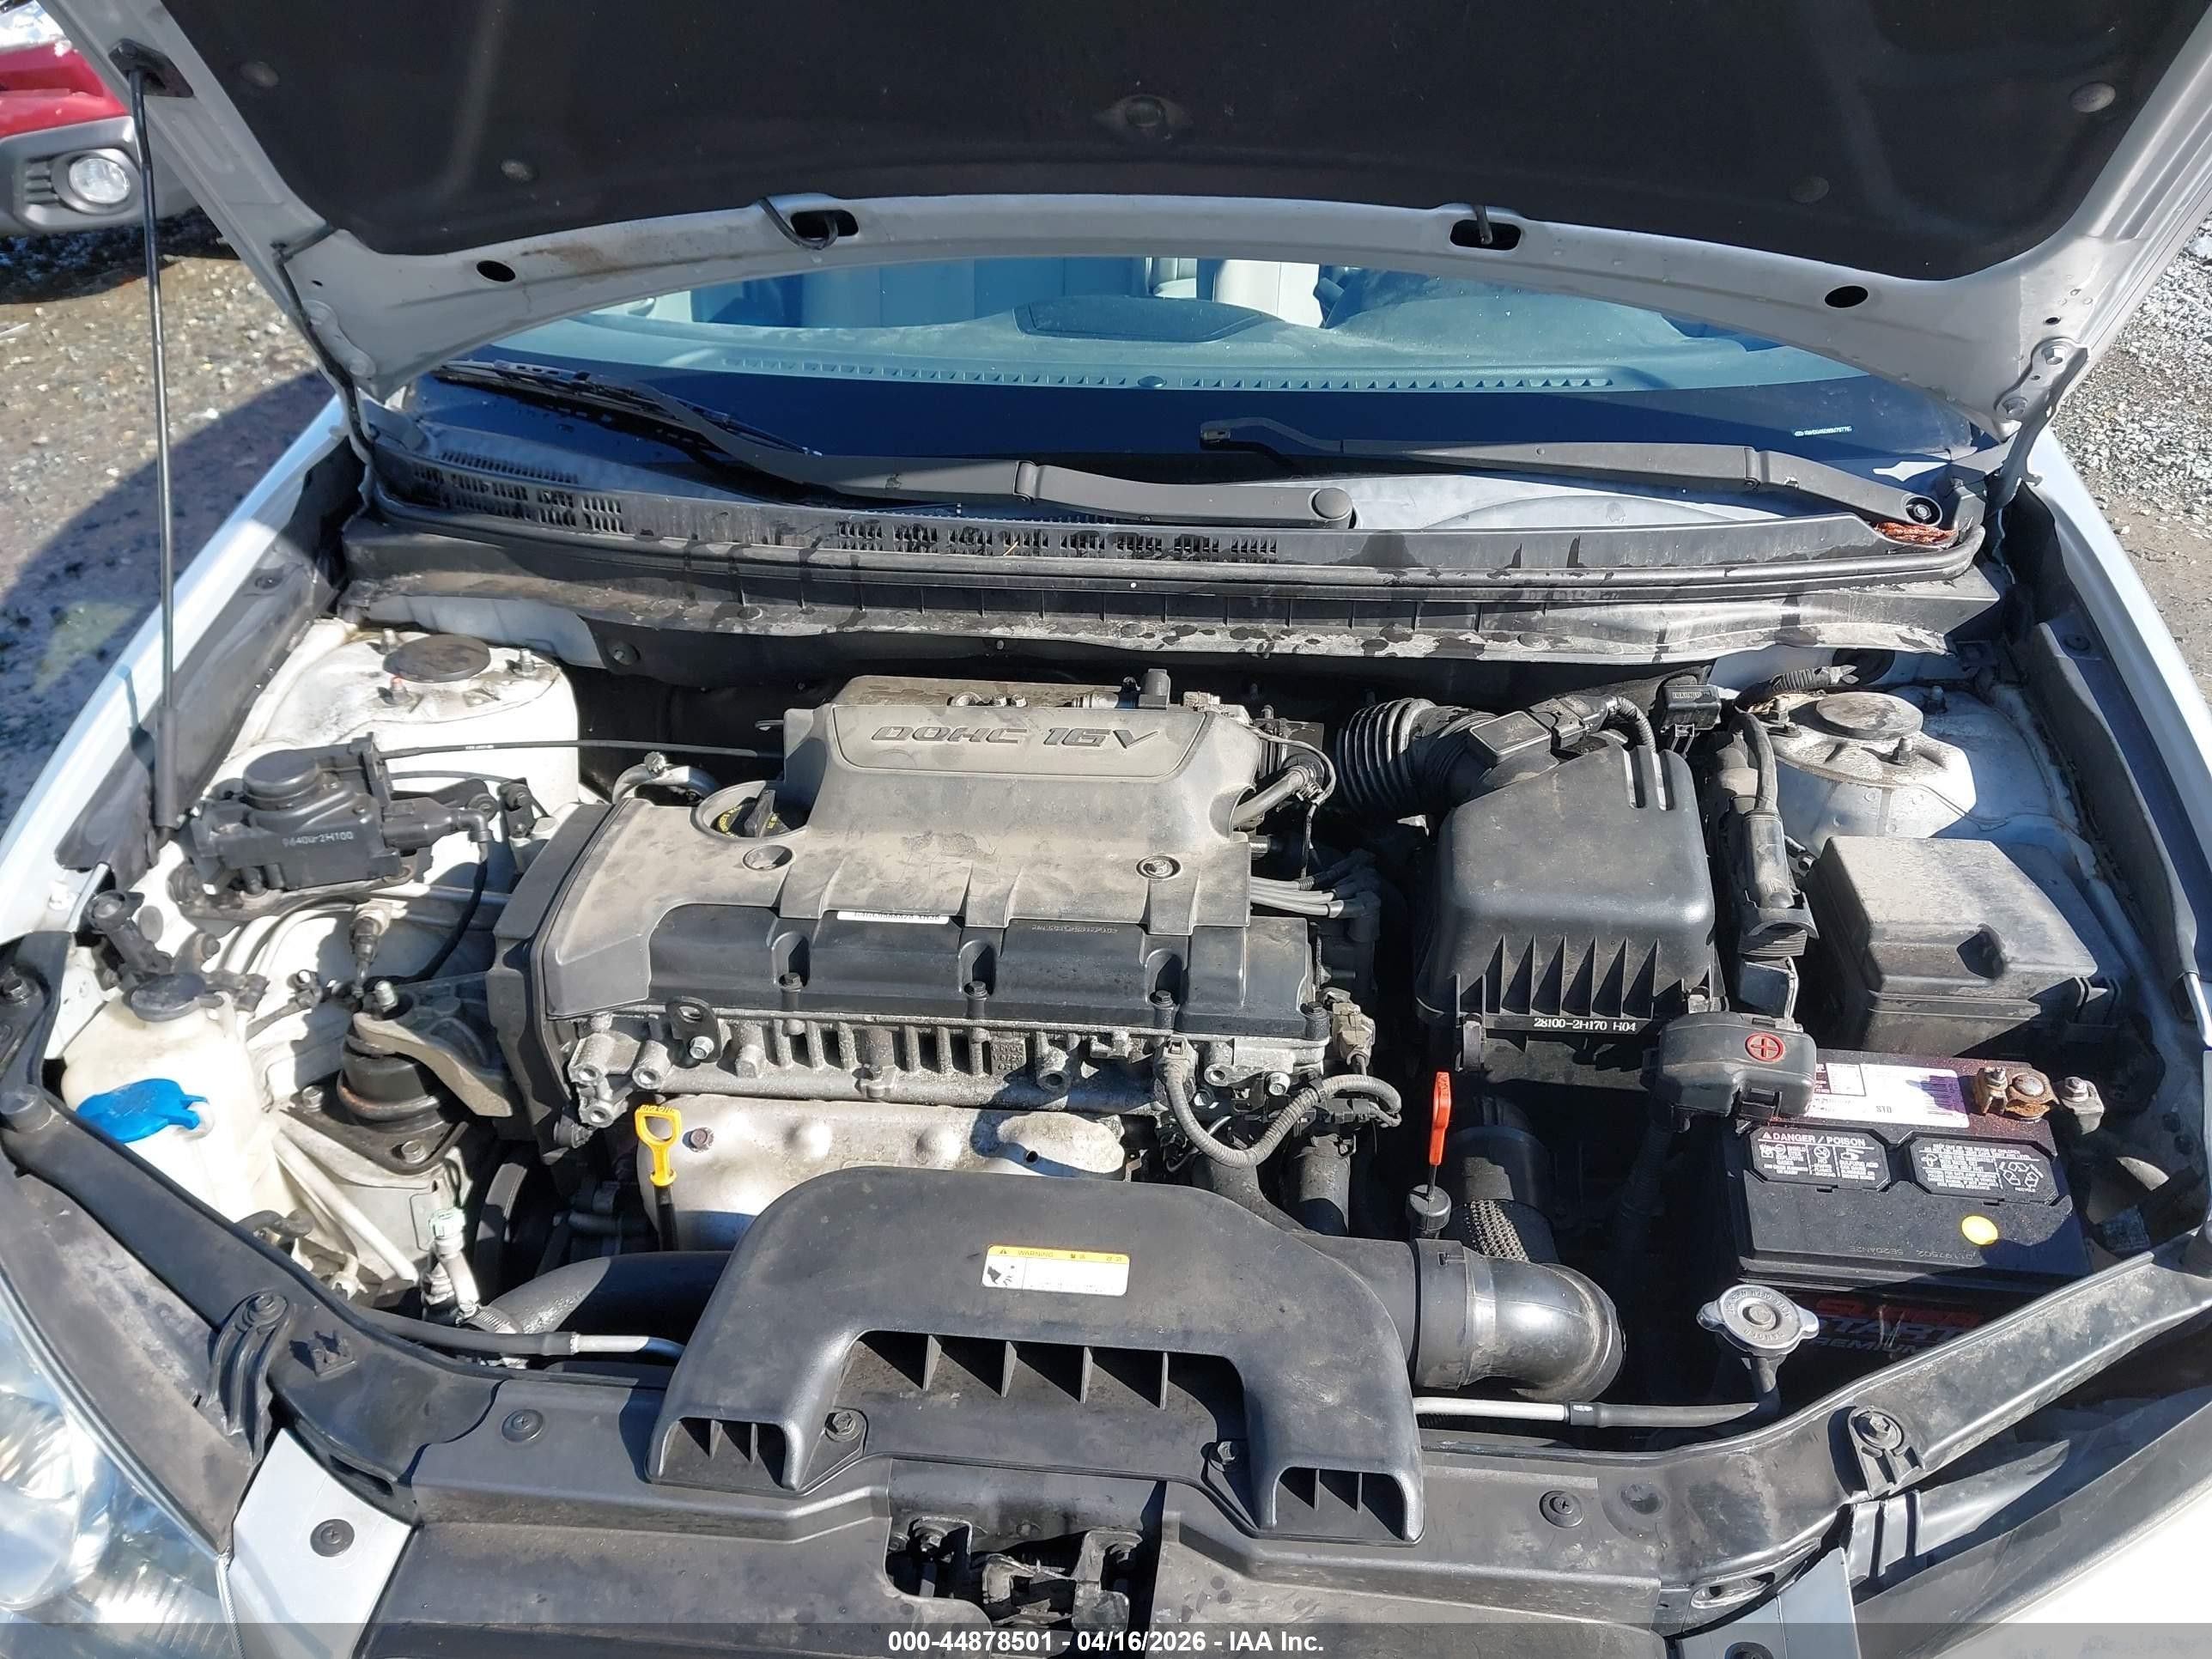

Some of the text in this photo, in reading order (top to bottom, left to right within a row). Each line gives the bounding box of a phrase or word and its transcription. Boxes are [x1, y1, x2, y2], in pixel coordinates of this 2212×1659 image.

[871, 726, 1159, 749] DOHC 16V
[1534, 1018, 1637, 1031] 28100-2H170 H04
[1773, 1133, 1815, 1143] DANGER
[1826, 1136, 1866, 1146] POISON
[1018, 1249, 1054, 1258] WARNING
